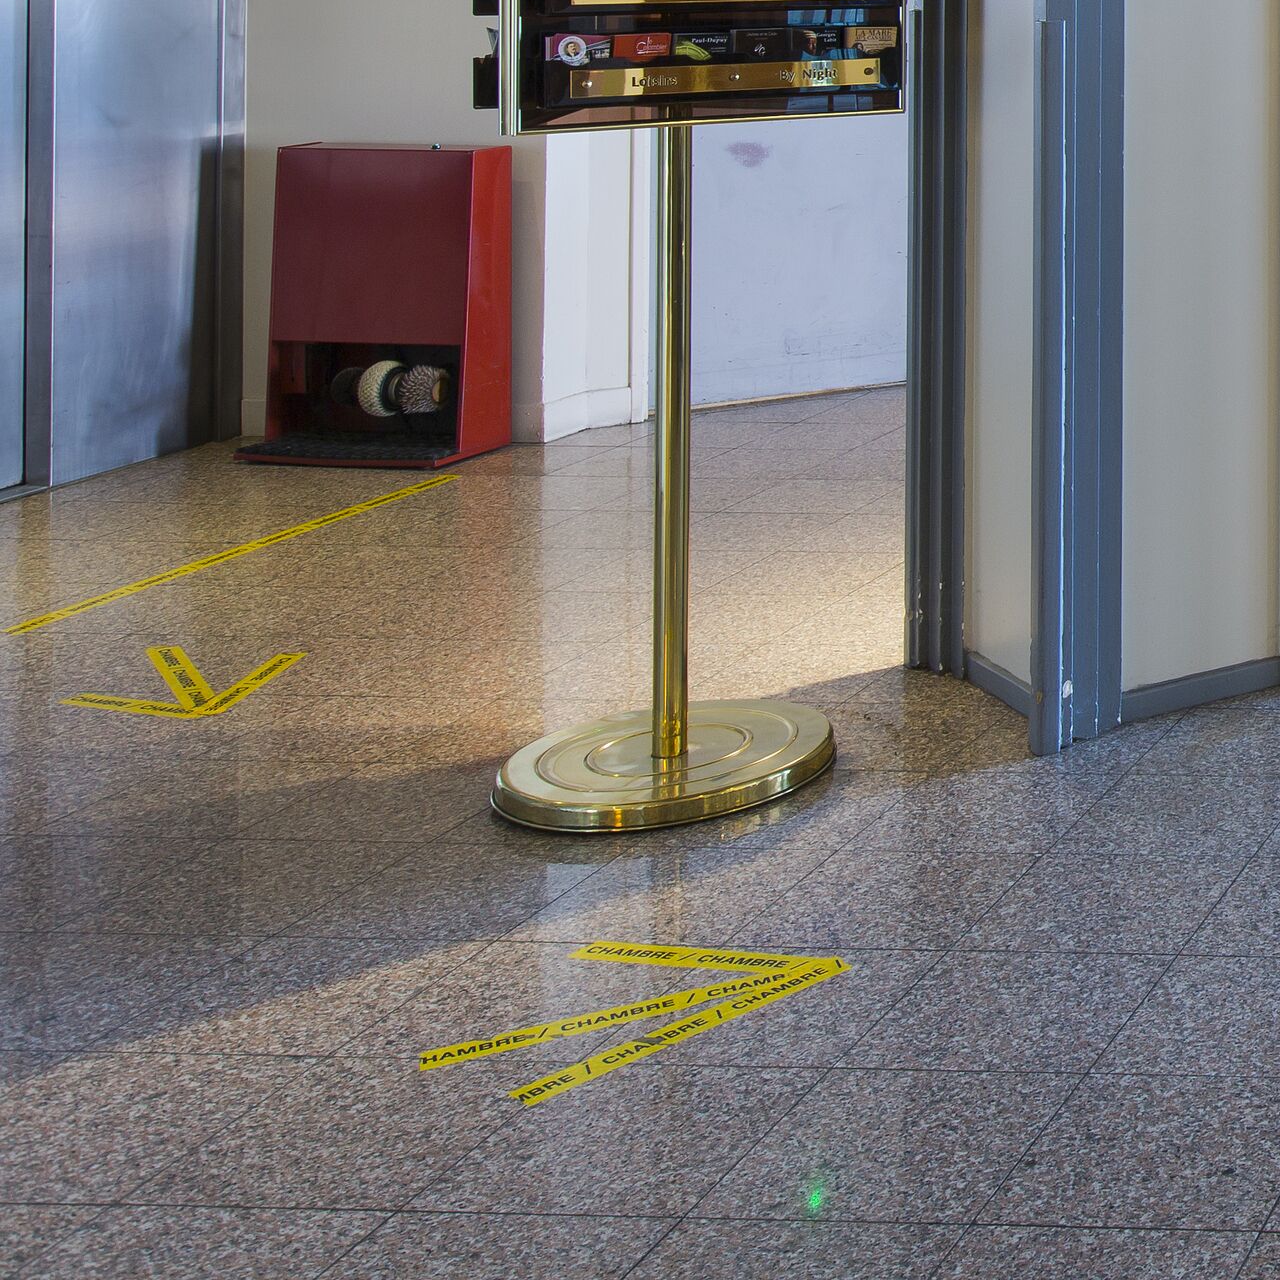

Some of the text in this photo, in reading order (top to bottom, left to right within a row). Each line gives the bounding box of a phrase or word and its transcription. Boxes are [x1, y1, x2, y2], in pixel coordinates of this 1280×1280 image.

[779, 69, 795, 83] By
[802, 68, 838, 81] Night
[70, 696, 132, 708] CHAMBRE
[585, 945, 676, 960] CHAMBRE
[696, 954, 790, 969] CHAMBRE
[731, 967, 829, 1010] CHAMBRE
[421, 1033, 529, 1066] HAMBRE
[560, 999, 675, 1032] CHAMBRE
